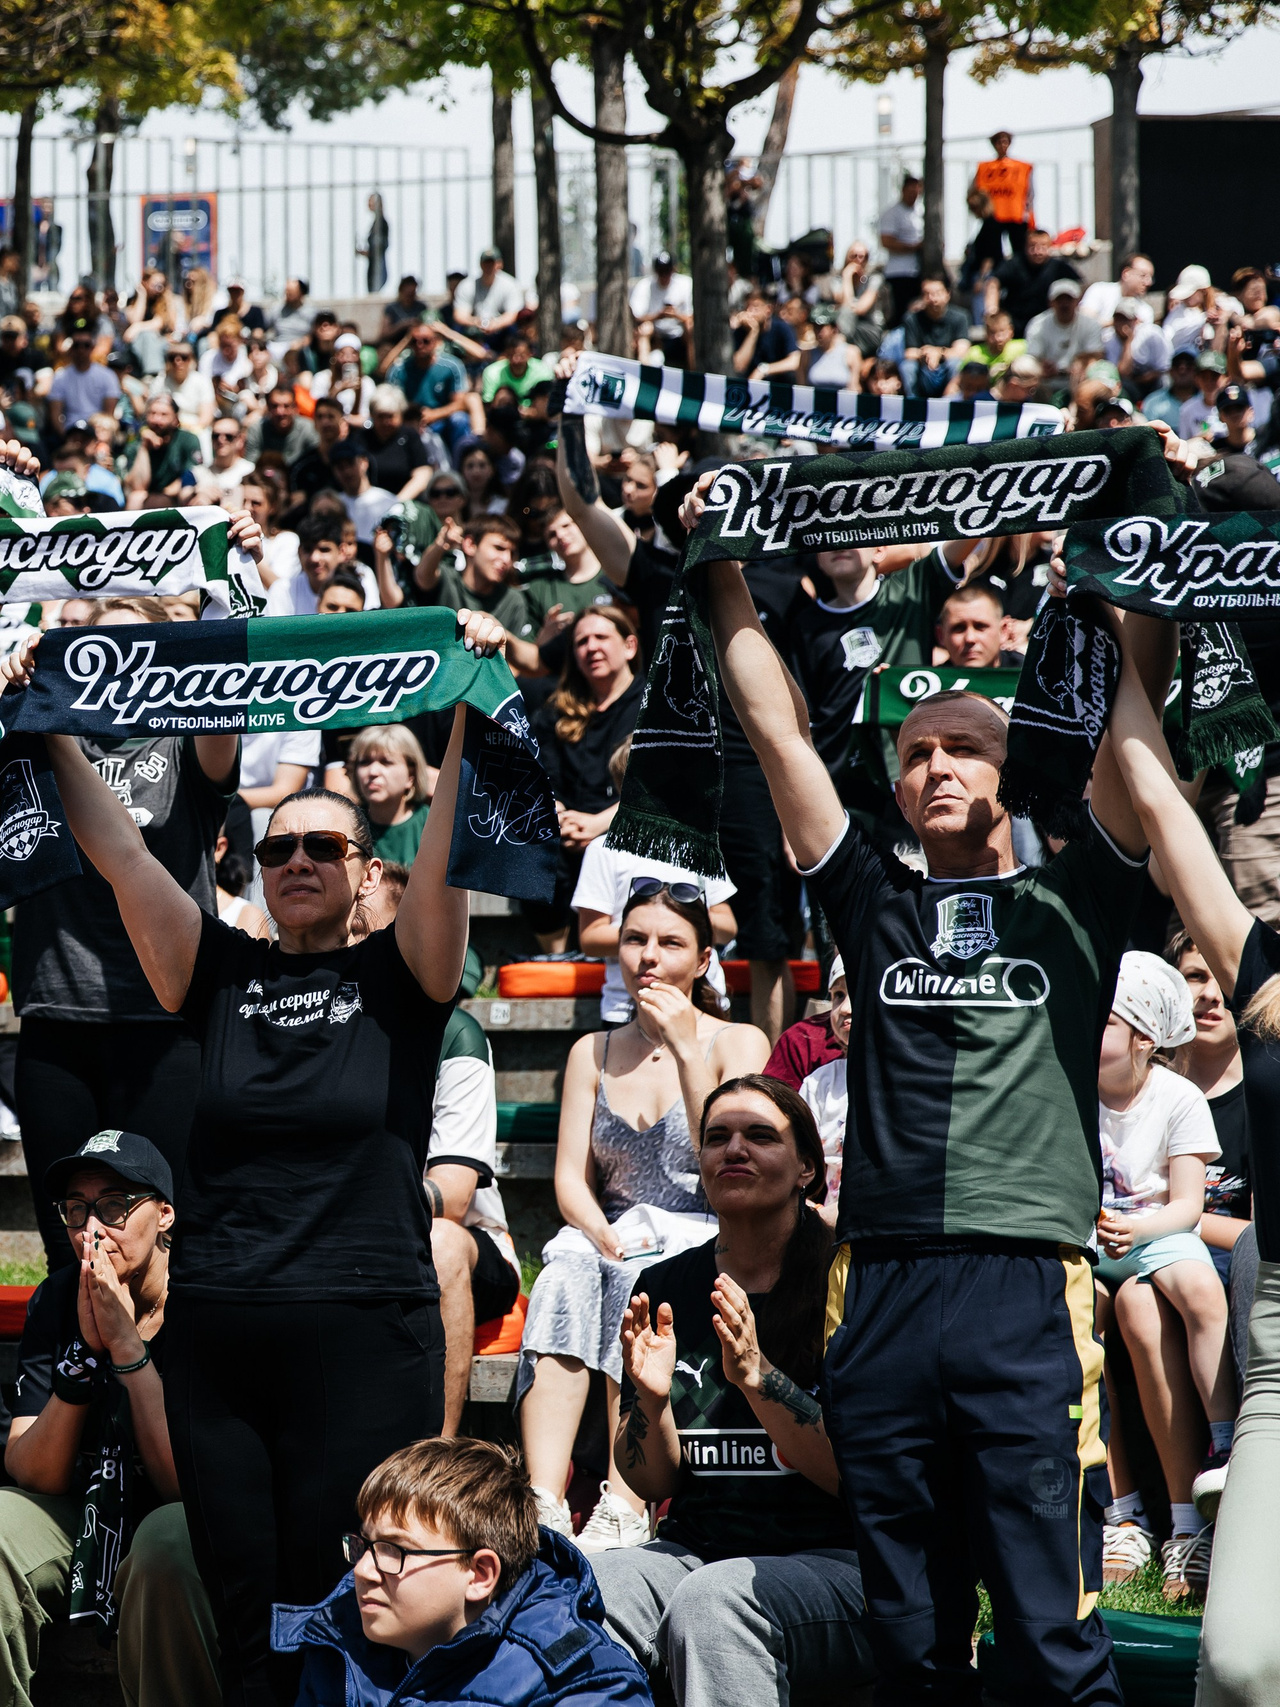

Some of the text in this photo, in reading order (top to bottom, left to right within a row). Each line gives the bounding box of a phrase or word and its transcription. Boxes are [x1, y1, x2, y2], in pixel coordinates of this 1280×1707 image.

[706, 454, 1112, 552] Краснодар
[802, 521, 940, 547] ФУТБОЛЬНЫЙ КЛУБ
[63, 634, 441, 726] Краснодар
[148, 712, 286, 732] ФУТБОЛЬНЫЙ КЛУБ
[484, 732, 528, 750] ЧЕРНИ
[279, 988, 331, 1012] сердце
[1032, 1502, 1069, 1521] pitbull
